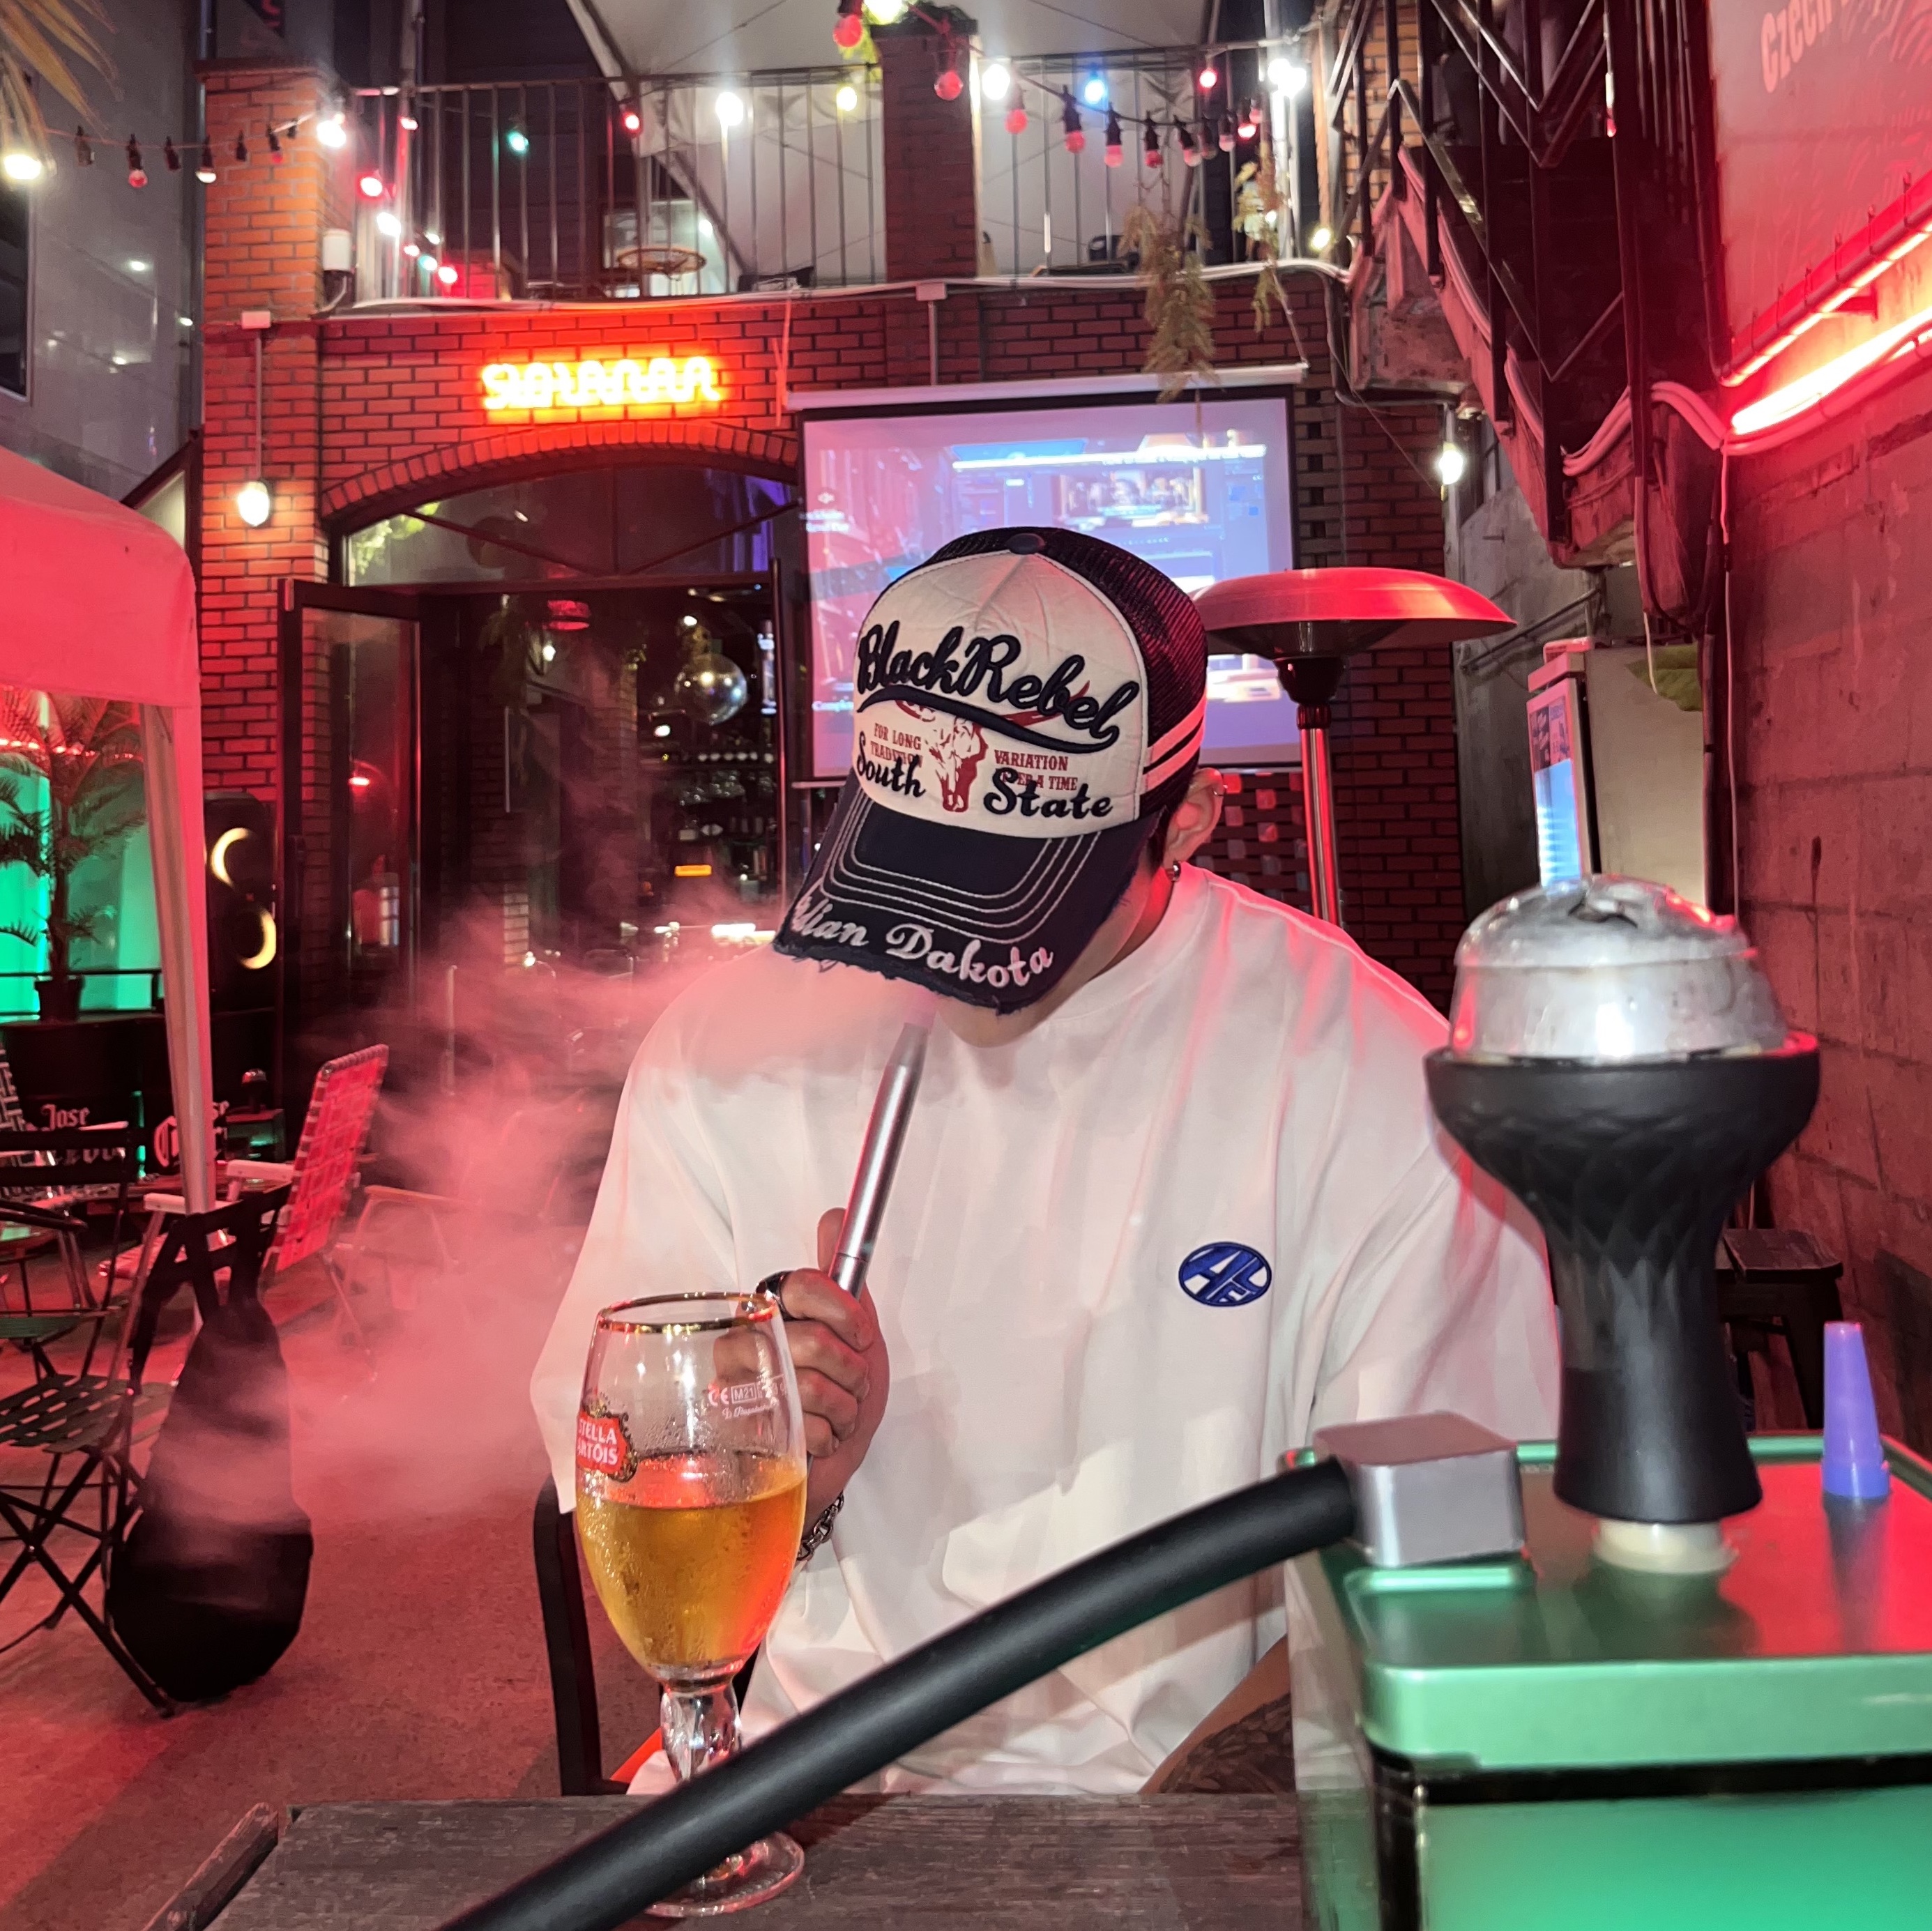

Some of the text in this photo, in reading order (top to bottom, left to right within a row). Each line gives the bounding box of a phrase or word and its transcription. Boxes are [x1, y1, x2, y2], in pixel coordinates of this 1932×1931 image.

[874, 722, 922, 750] FOR LONG
[994, 749, 1070, 771] VARIATION
[857, 729, 1113, 820] South State
[1048, 776, 1079, 791] TIME
[885, 923, 1054, 988] Dakota
[734, 1387, 754, 1400] M21
[578, 1418, 617, 1445] STELLA
[577, 1437, 618, 1465] ARTOIS
